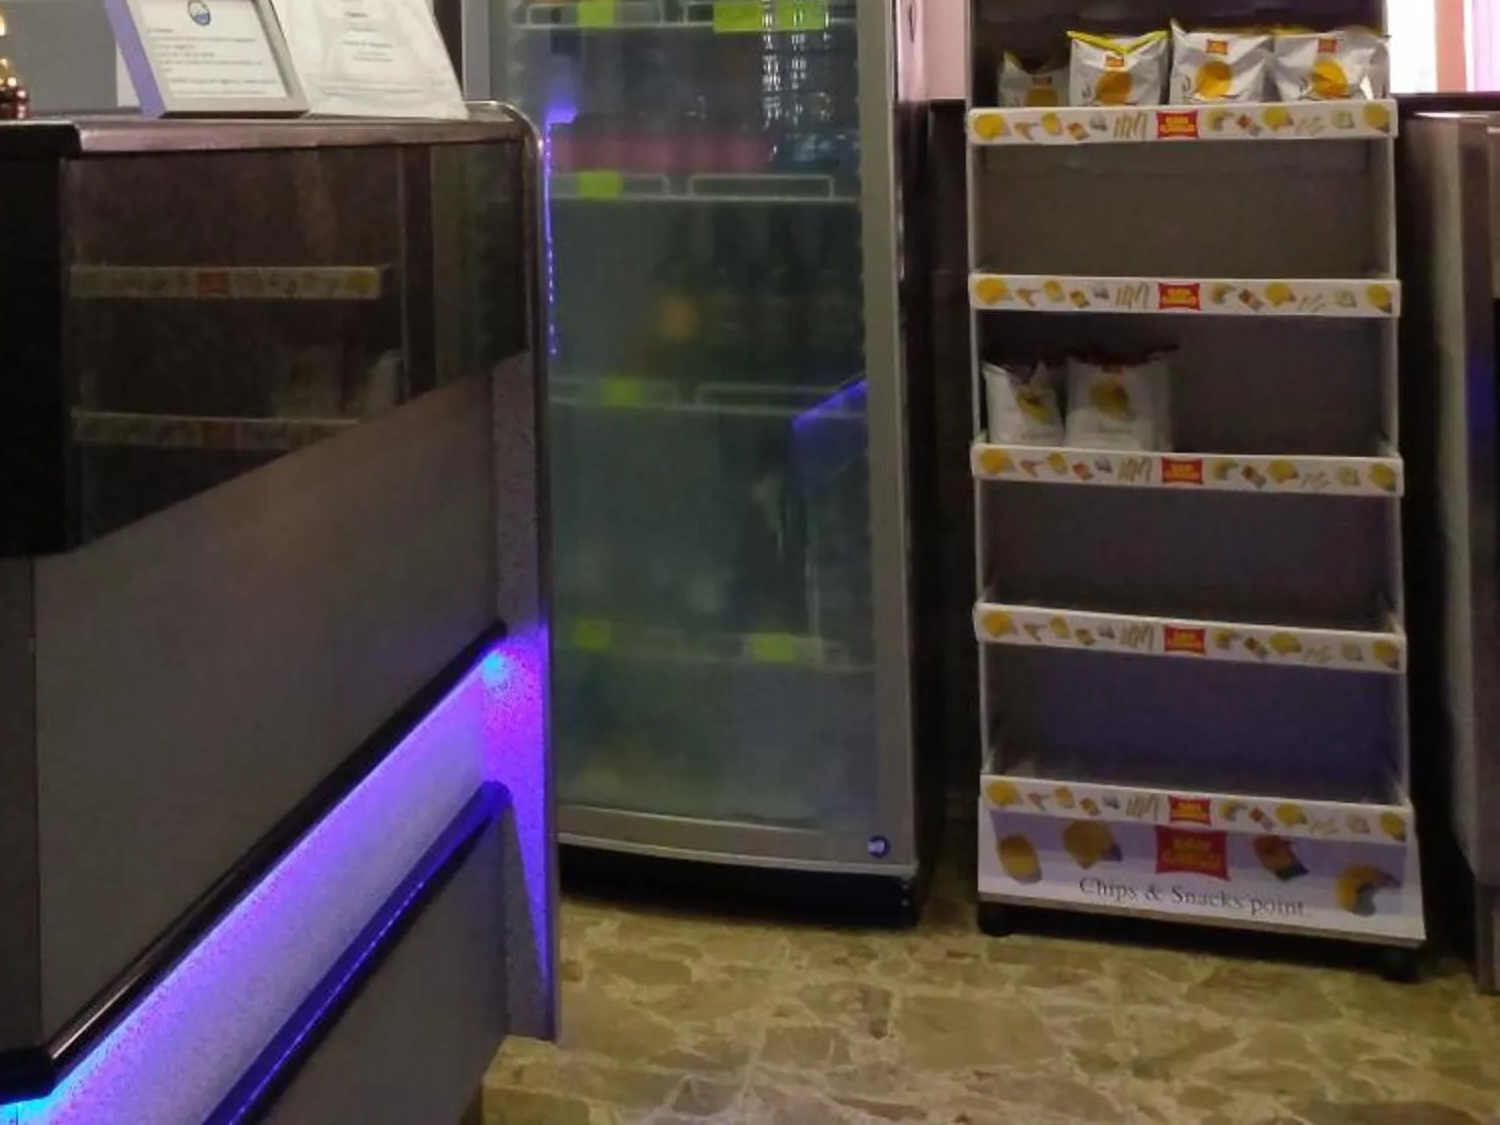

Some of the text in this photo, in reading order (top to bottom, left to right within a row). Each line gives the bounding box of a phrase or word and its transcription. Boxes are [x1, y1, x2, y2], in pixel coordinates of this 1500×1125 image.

[1078, 876, 1138, 901] Chips
[1145, 884, 1163, 901] &
[1171, 885, 1244, 909] Snacks
